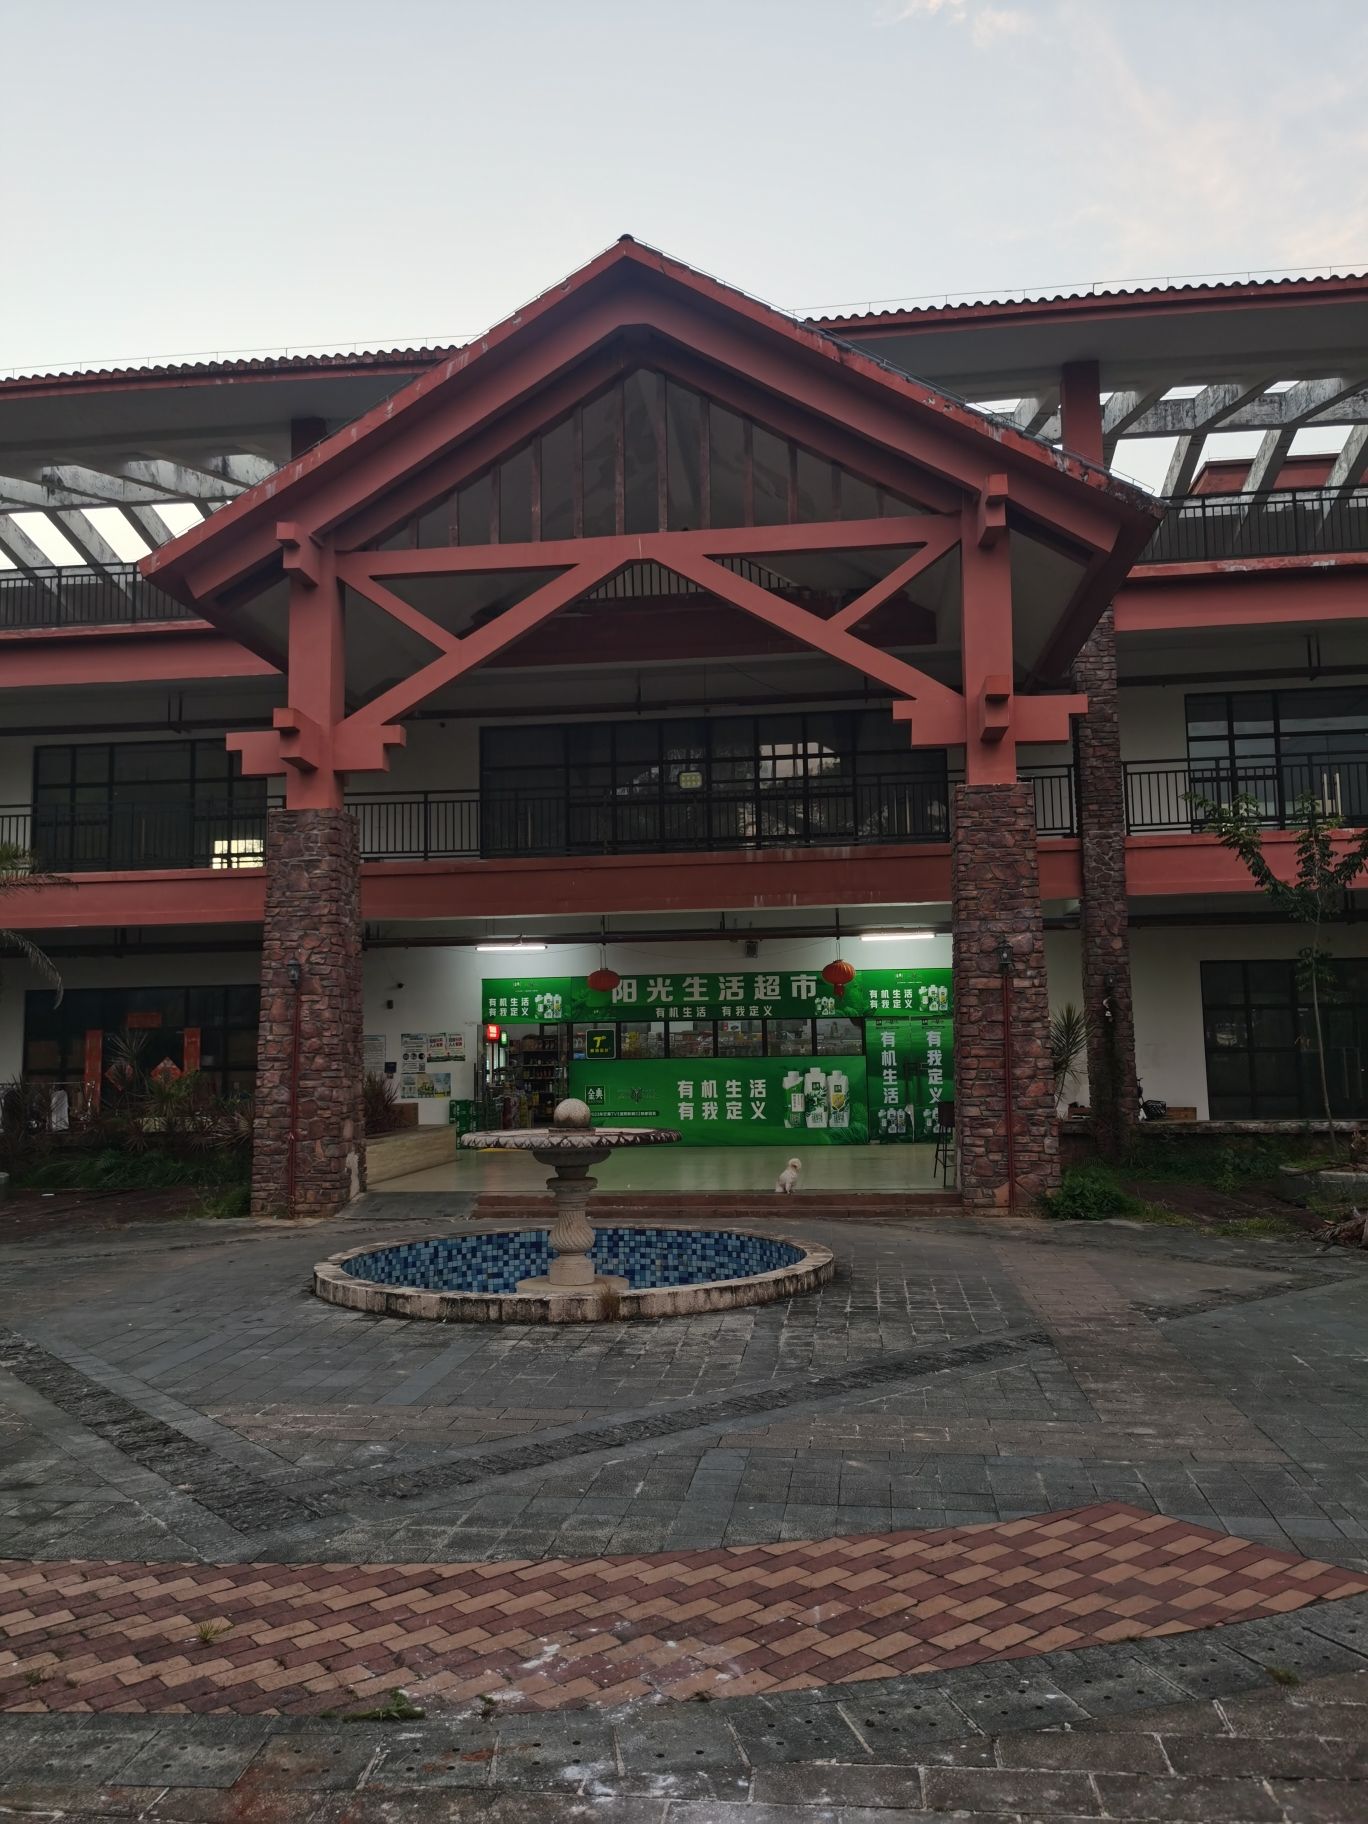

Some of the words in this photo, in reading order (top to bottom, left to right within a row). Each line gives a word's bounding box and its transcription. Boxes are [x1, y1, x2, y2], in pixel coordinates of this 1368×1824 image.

[611, 973, 818, 1004] 阳光生活超市
[869, 988, 913, 999] 有机生活
[488, 997, 530, 1007] 有机生活
[869, 999, 913, 1009] 有我定义
[488, 1007, 530, 1017] 有我定义
[655, 1006, 707, 1019] 有机生活
[721, 1005, 773, 1017] 有我定义
[880, 1031, 899, 1104] 有机生活
[925, 1030, 944, 1104] 有我定义
[677, 1079, 768, 1099] 有机生活
[677, 1101, 768, 1121] 有我定义
